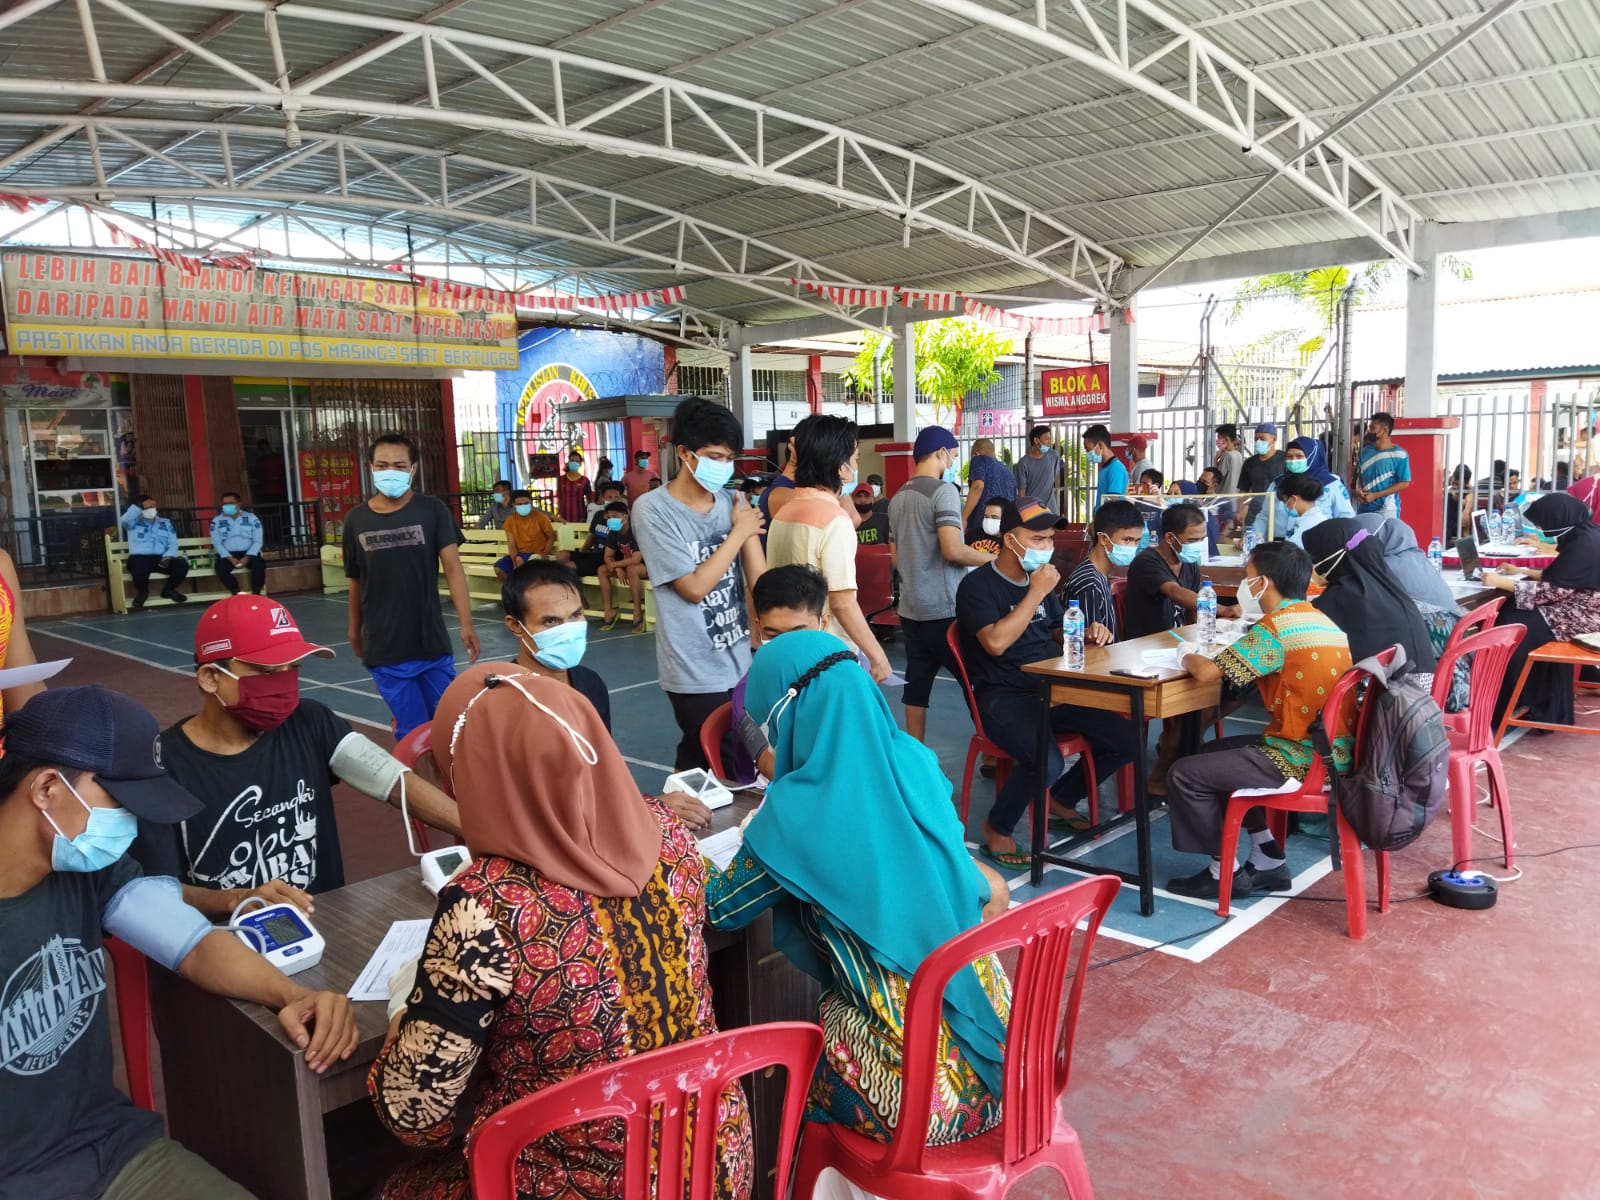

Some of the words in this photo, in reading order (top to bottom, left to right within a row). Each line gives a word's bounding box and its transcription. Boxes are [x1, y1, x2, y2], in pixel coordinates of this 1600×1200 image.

[109, 260, 168, 287] BAIK
[179, 266, 254, 293] MANDI
[264, 271, 366, 302] KERINGAT
[374, 282, 419, 306] SAAT
[16, 289, 149, 321] DARIPADA
[162, 298, 237, 324] MANDI
[247, 302, 284, 327] AIR
[294, 306, 347, 331] MATA
[356, 310, 404, 334] SAAT
[16, 330, 125, 351] PASTIKAN
[131, 334, 184, 354] ANDA
[190, 336, 263, 356] BERADA
[268, 339, 284, 357] DI
[290, 341, 322, 358] POS
[400, 346, 438, 363] SAAT
[444, 348, 516, 367] BERTUGAS
[1050, 375, 1087, 394] BLOK
[1091, 374, 1100, 390] A
[1045, 396, 1069, 408] WISMA
[1071, 393, 1107, 407] ANGGREK
[22, 1050, 57, 1071] NEVER
